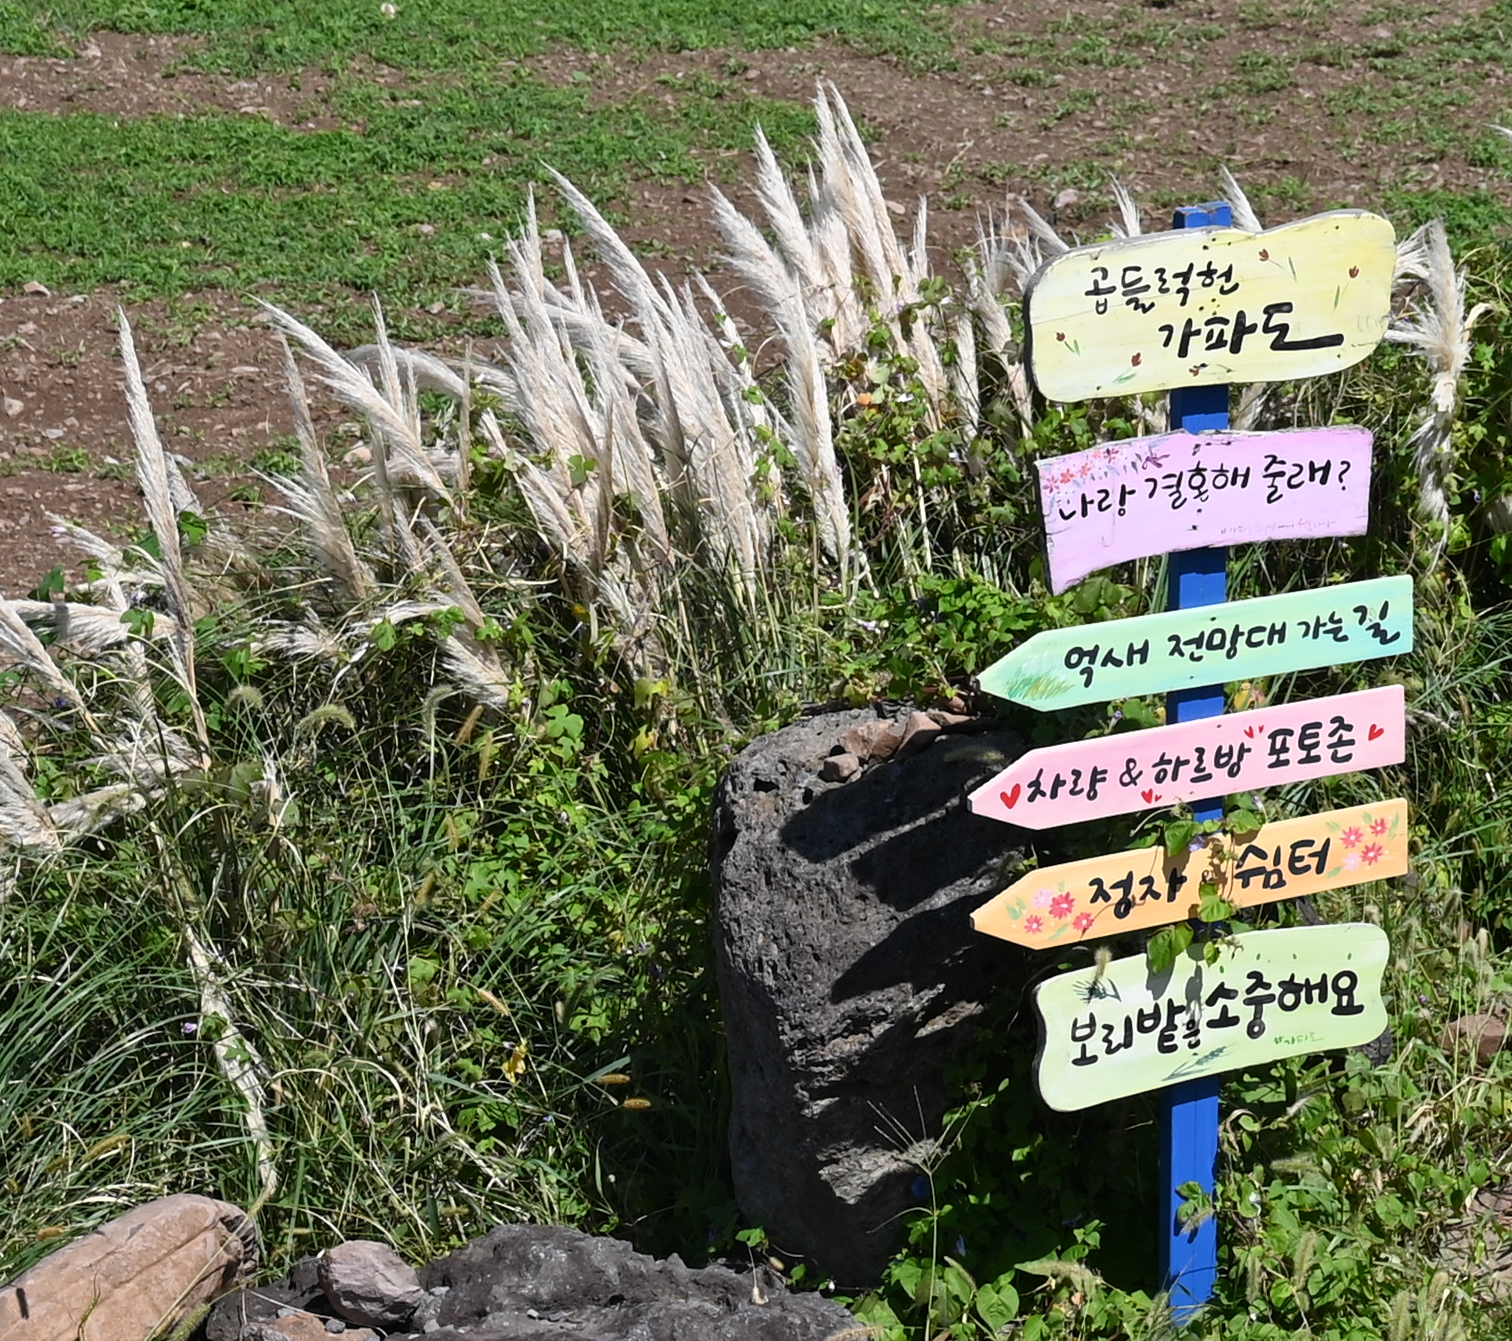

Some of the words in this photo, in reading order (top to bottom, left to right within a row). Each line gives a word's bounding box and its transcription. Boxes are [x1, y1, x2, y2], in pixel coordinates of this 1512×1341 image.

[1157, 301, 1345, 358] 가파도
[1059, 484, 1136, 521] 나랑
[1144, 461, 1251, 510] 결혼해
[1262, 454, 1351, 504] 줄래?
[1064, 639, 1149, 688] 억새
[1167, 621, 1286, 662] 전망대
[1297, 611, 1349, 642] 가는
[1353, 600, 1401, 645] 길
[1027, 766, 1108, 803] 차량
[1119, 758, 1143, 787] &
[1152, 742, 1252, 784] 하르방
[1267, 715, 1356, 769] 포토존
[1088, 867, 1188, 920] 정자
[1234, 836, 1331, 890] 쉼터
[1204, 970, 1365, 1040] 소중해요
